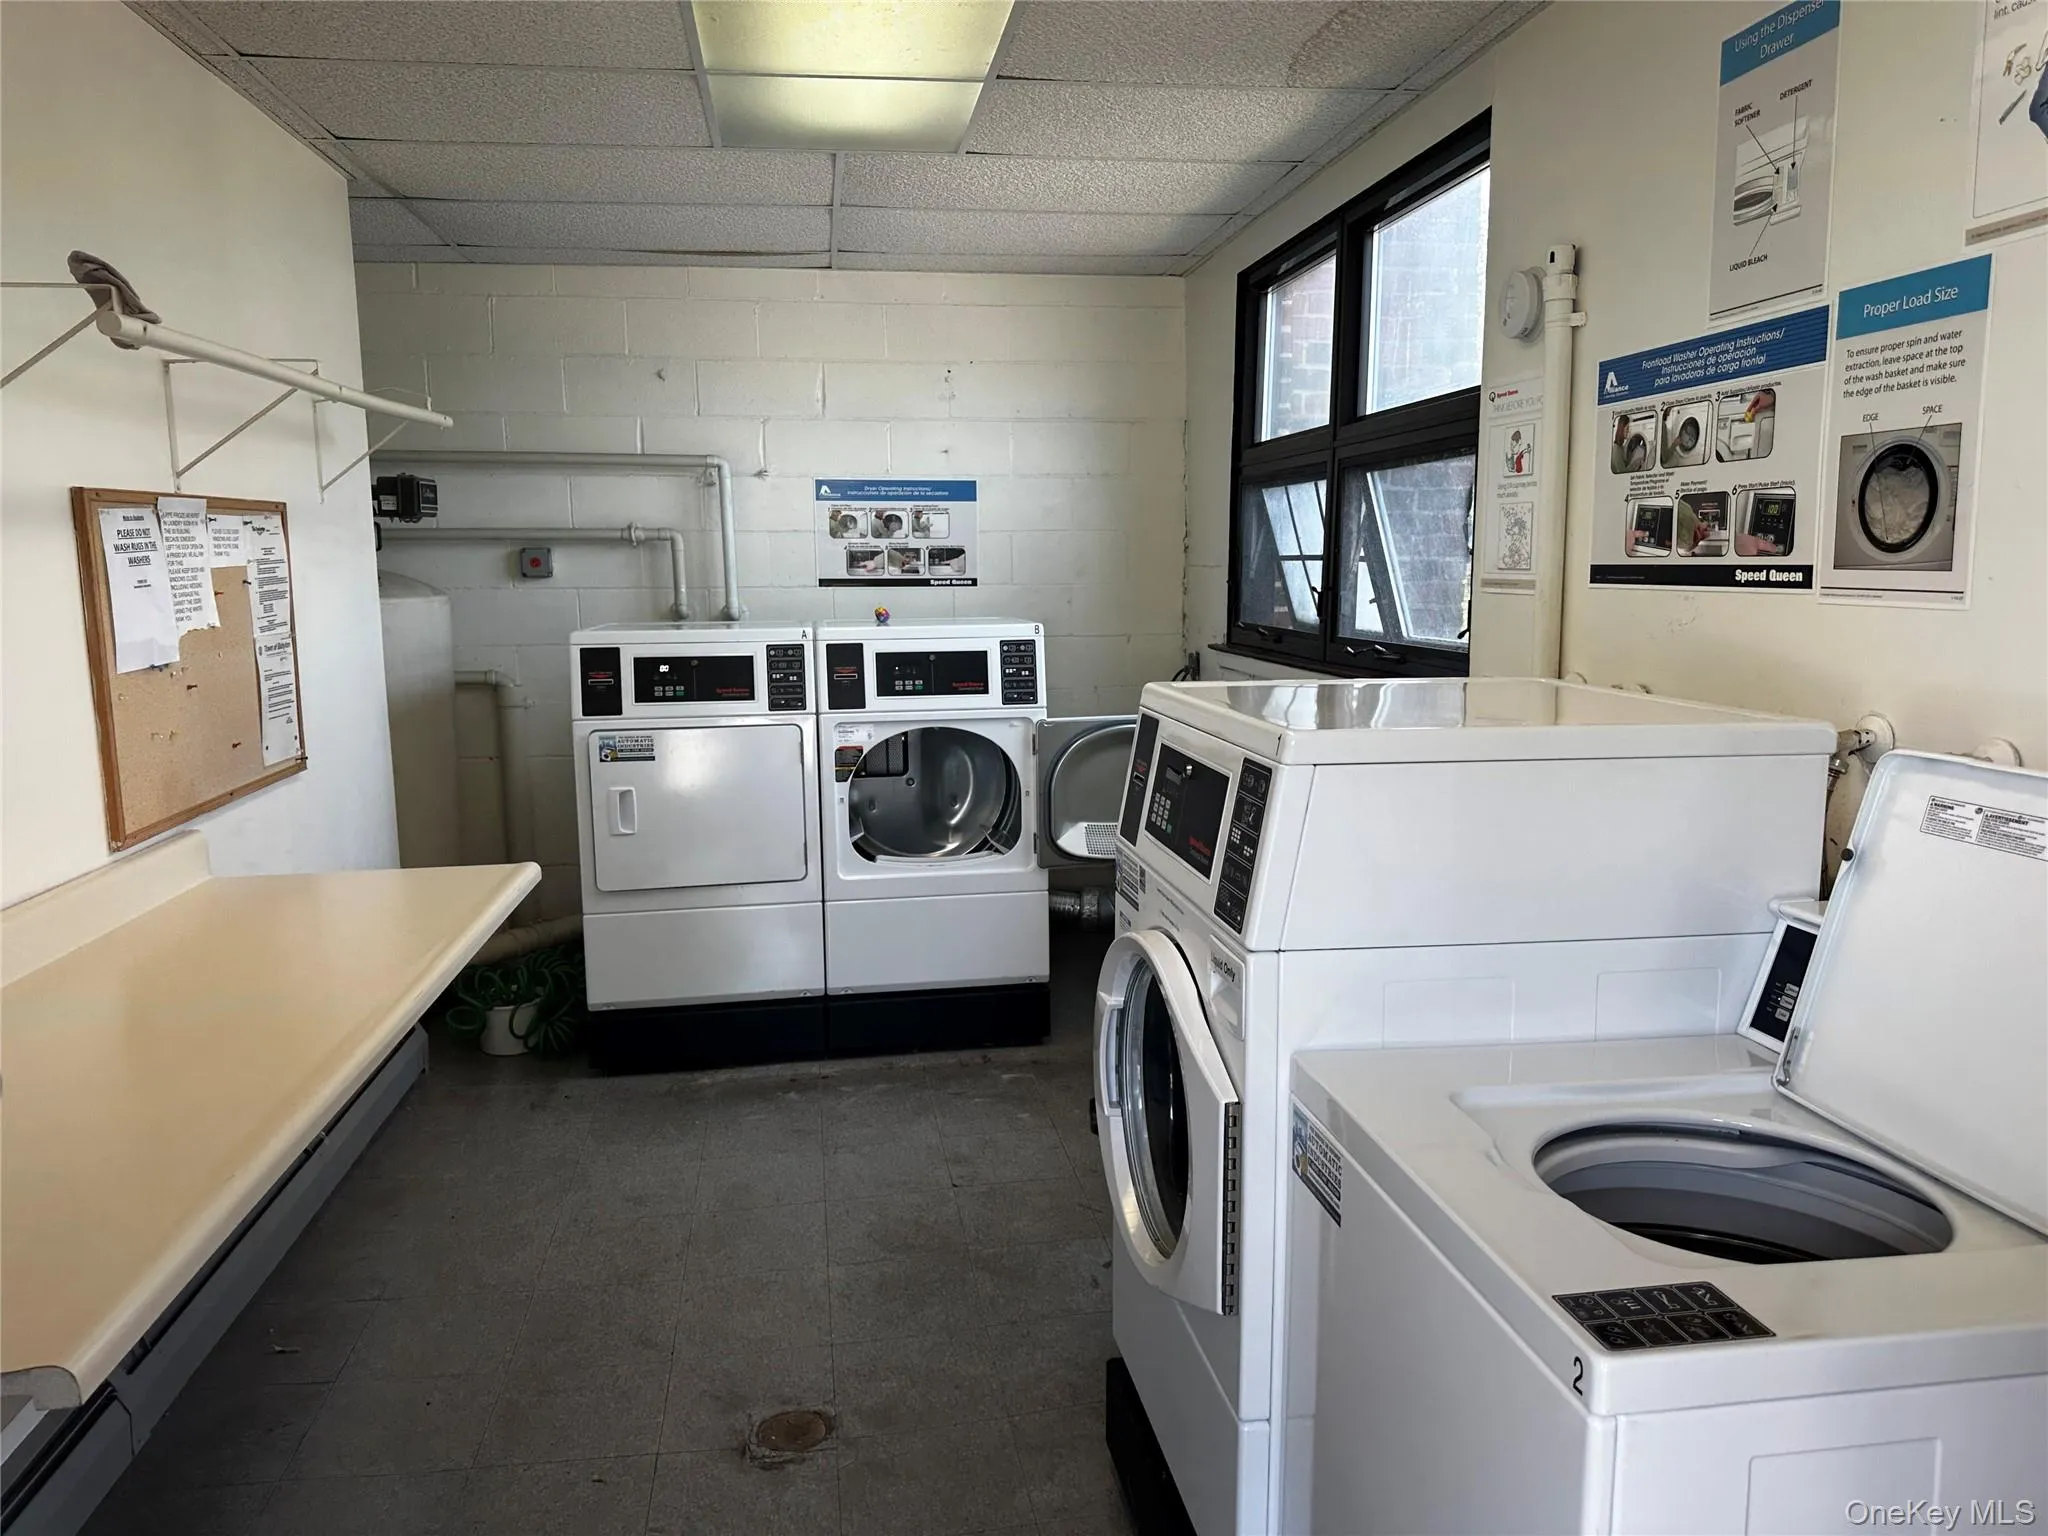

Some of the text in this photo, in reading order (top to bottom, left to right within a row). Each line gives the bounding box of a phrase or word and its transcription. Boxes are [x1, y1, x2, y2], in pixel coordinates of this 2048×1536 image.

[1734, 30, 1759, 52] Using
[1760, 22, 1776, 38] the
[1760, 33, 1794, 58] Drawer
[1780, 79, 1813, 100] DETERGENT
[1734, 102, 1753, 116] FABRIC
[1734, 109, 1761, 127] SOFTENER
[1729, 253, 1768, 272] LIQUID BLEACH
[1863, 286, 1959, 318] Proper Load Size
[1641, 328, 1785, 370] Frontload Washer Operating Instructions/
[1846, 330, 1963, 359] To ensure proper spin and water
[1661, 359, 1705, 374] Instrucciones
[1706, 354, 1717, 365] de
[1844, 343, 1964, 372] extraction, leave space at the top
[1654, 353, 1767, 388] para lavadoras de carga frontal
[1843, 358, 1966, 386] of the wash basket and make sure
[1843, 373, 1957, 399] the edge of the basket is visible.
[1715, 391, 1721, 402] 3
[1660, 401, 1666, 412] 2
[1922, 404, 1943, 415] SPACE
[1862, 412, 1880, 423] EDGE
[1674, 490, 1680, 500] 5
[1732, 484, 1738, 495] 6
[1624, 494, 1629, 504] 4
[117, 528, 150, 537] PLEASE DO NOT
[113, 542, 130, 551] WASH
[131, 542, 144, 550] RUGS
[149, 541, 157, 549] THE
[128, 555, 151, 565] WASHERS
[1735, 569, 1803, 583] Speed Queen
[801, 630, 807, 640] A
[1034, 625, 1040, 635] B
[1224, 962, 1236, 982] Only
[1308, 1131, 1342, 1177] AUTOMATIC
[1573, 1356, 1583, 1396] 2
